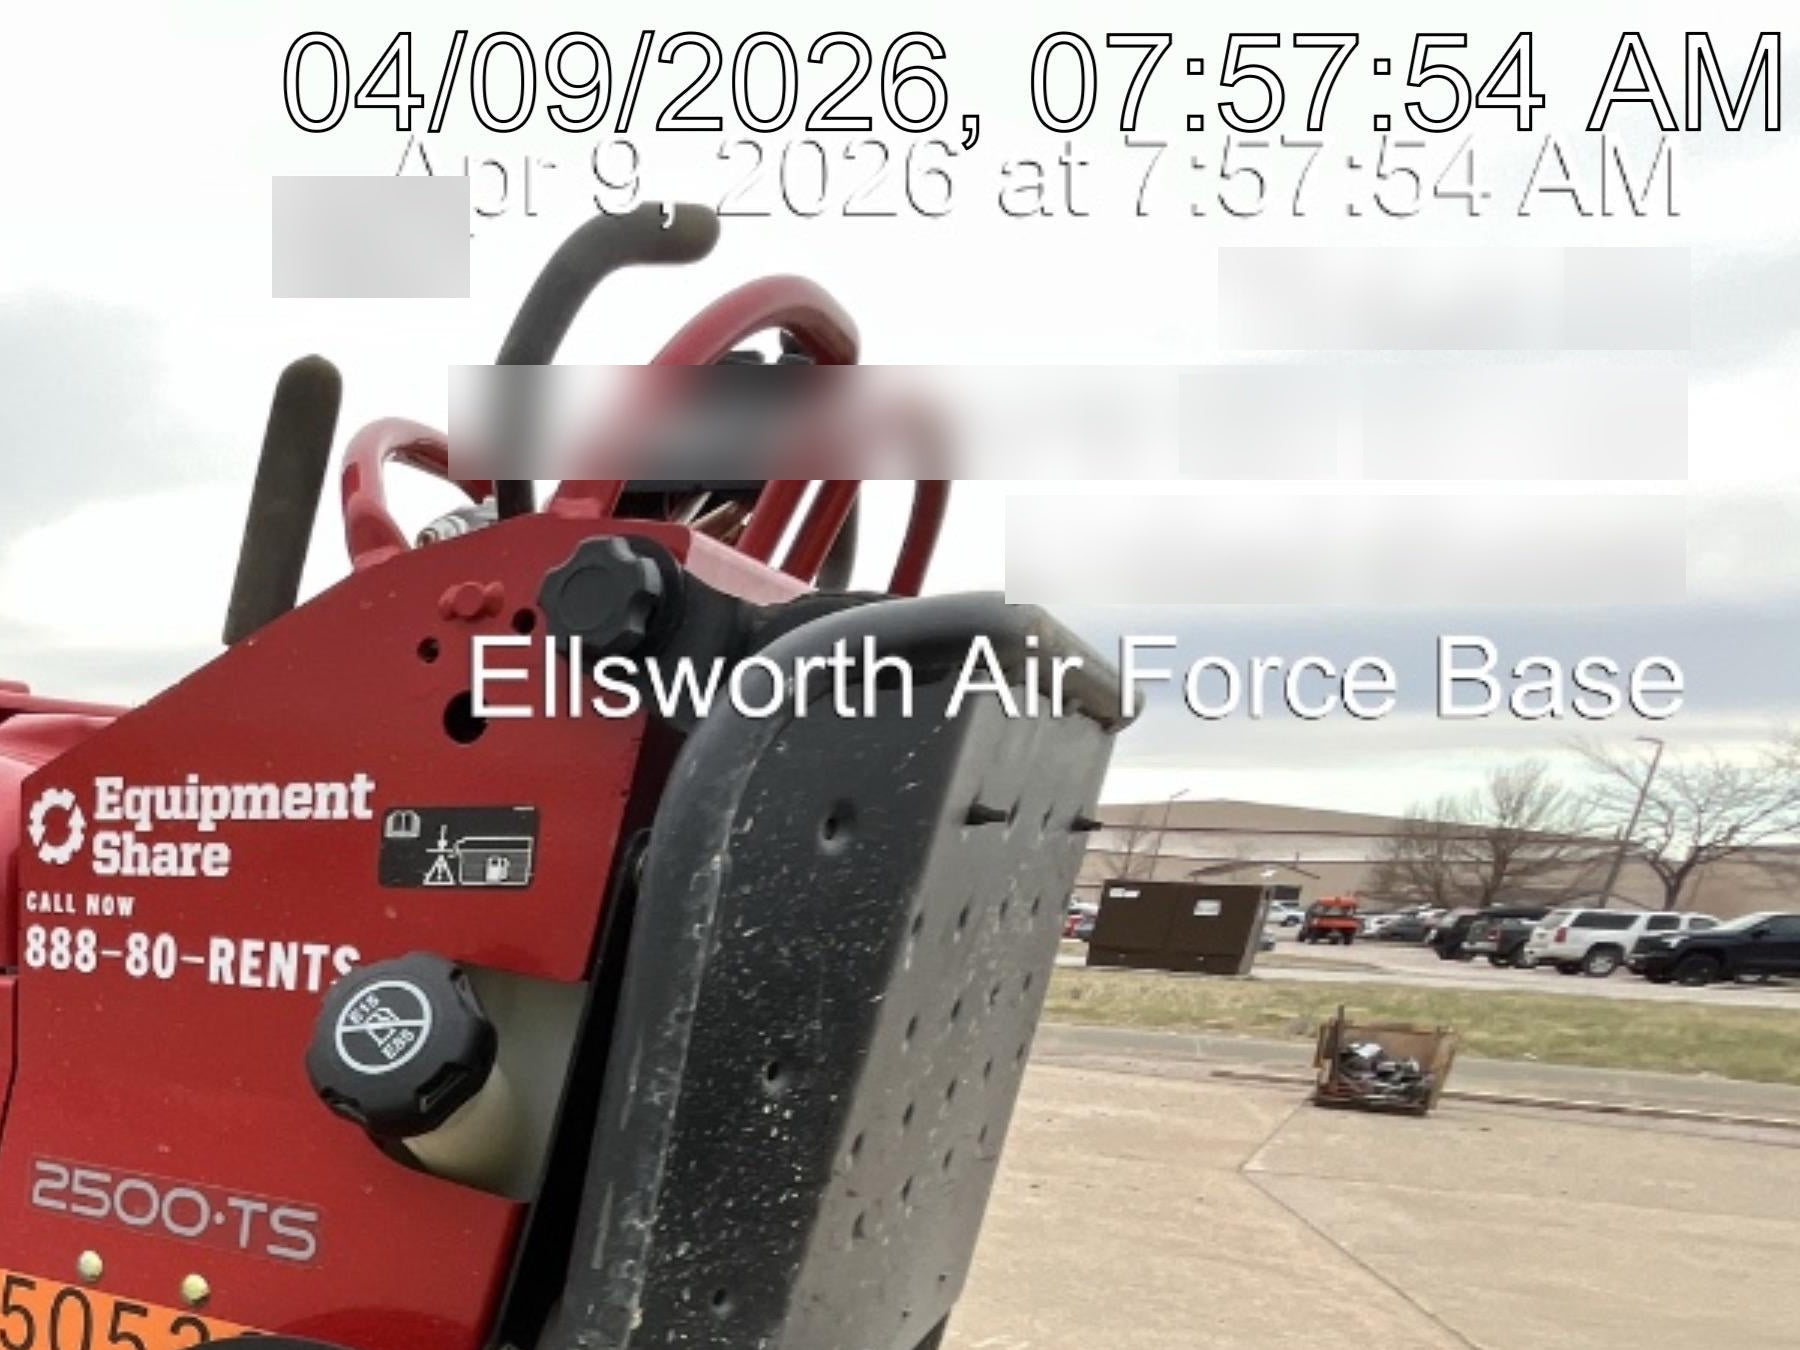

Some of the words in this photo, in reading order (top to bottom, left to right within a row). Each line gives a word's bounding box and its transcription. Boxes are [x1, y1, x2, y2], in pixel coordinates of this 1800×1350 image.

[93, 772, 376, 832] Equipment
[92, 830, 232, 877] Share
[25, 890, 77, 914] CALL
[86, 893, 136, 917] NOW
